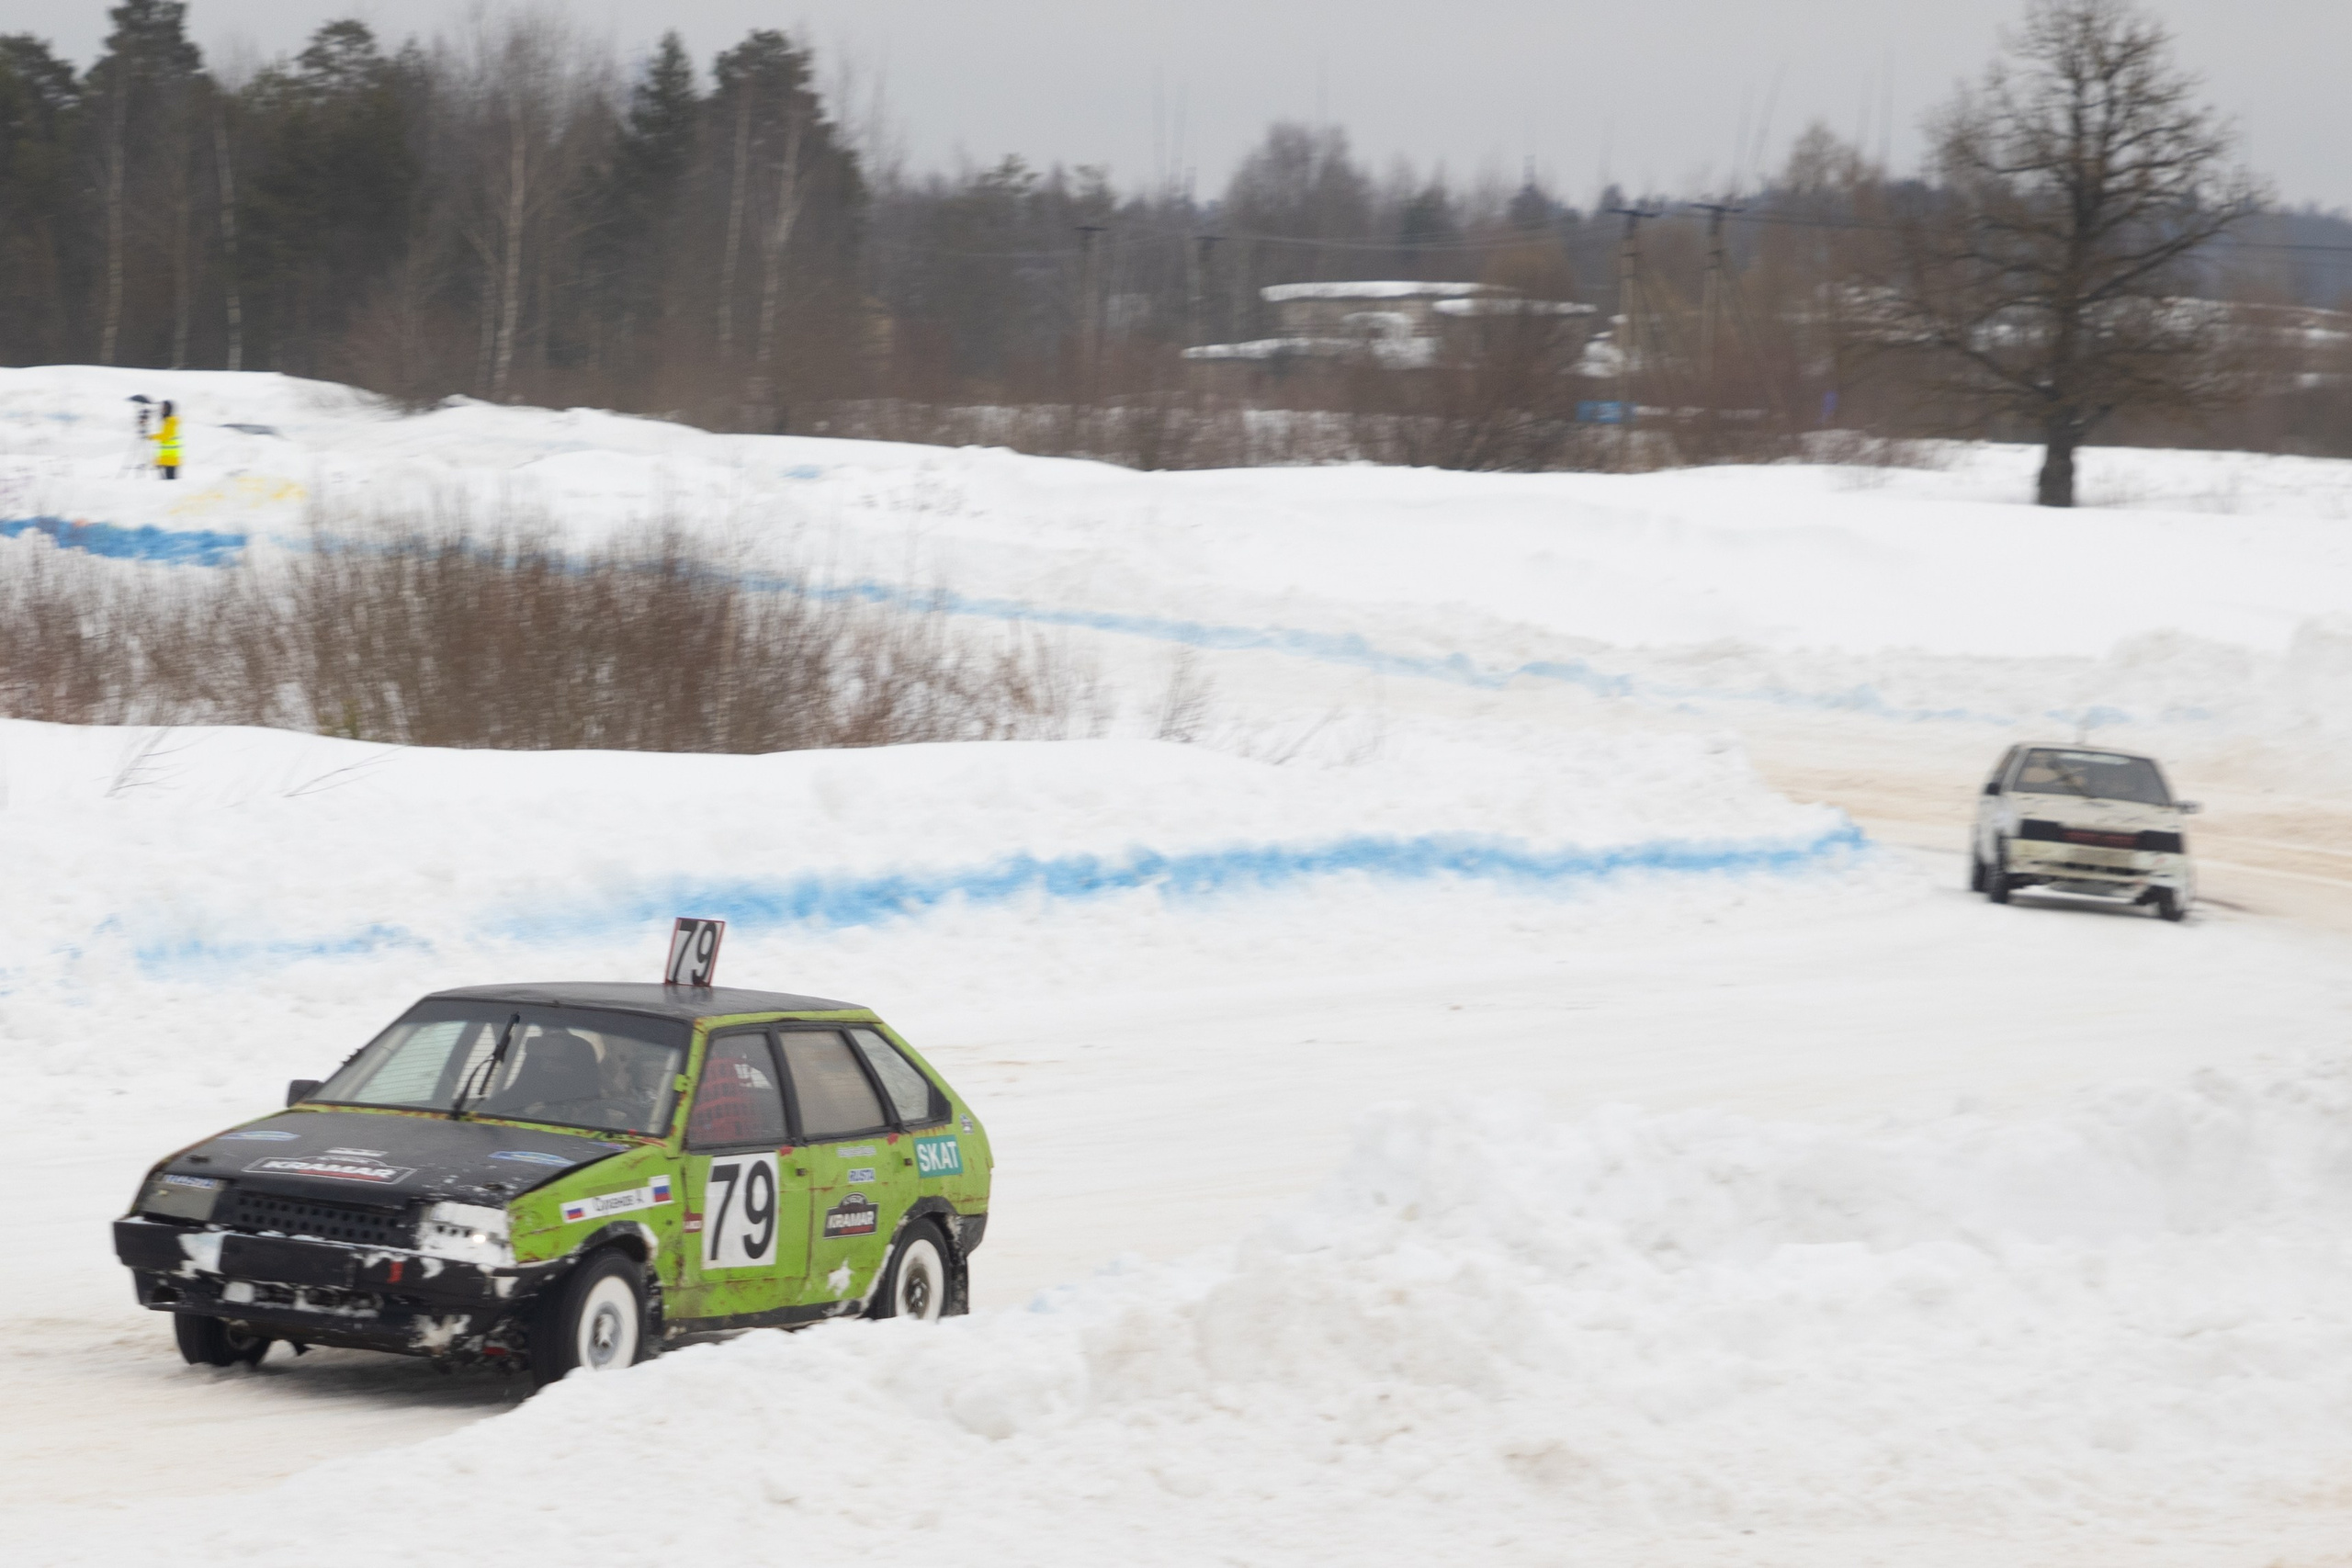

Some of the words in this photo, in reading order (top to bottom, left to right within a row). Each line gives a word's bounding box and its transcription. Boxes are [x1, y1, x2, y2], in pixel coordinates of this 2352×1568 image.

[673, 919, 717, 986] 79
[262, 1160, 398, 1179] KRAMAR
[916, 1141, 959, 1172] SKAT
[709, 1160, 775, 1260] 79
[826, 1211, 875, 1229] KRAMAR
